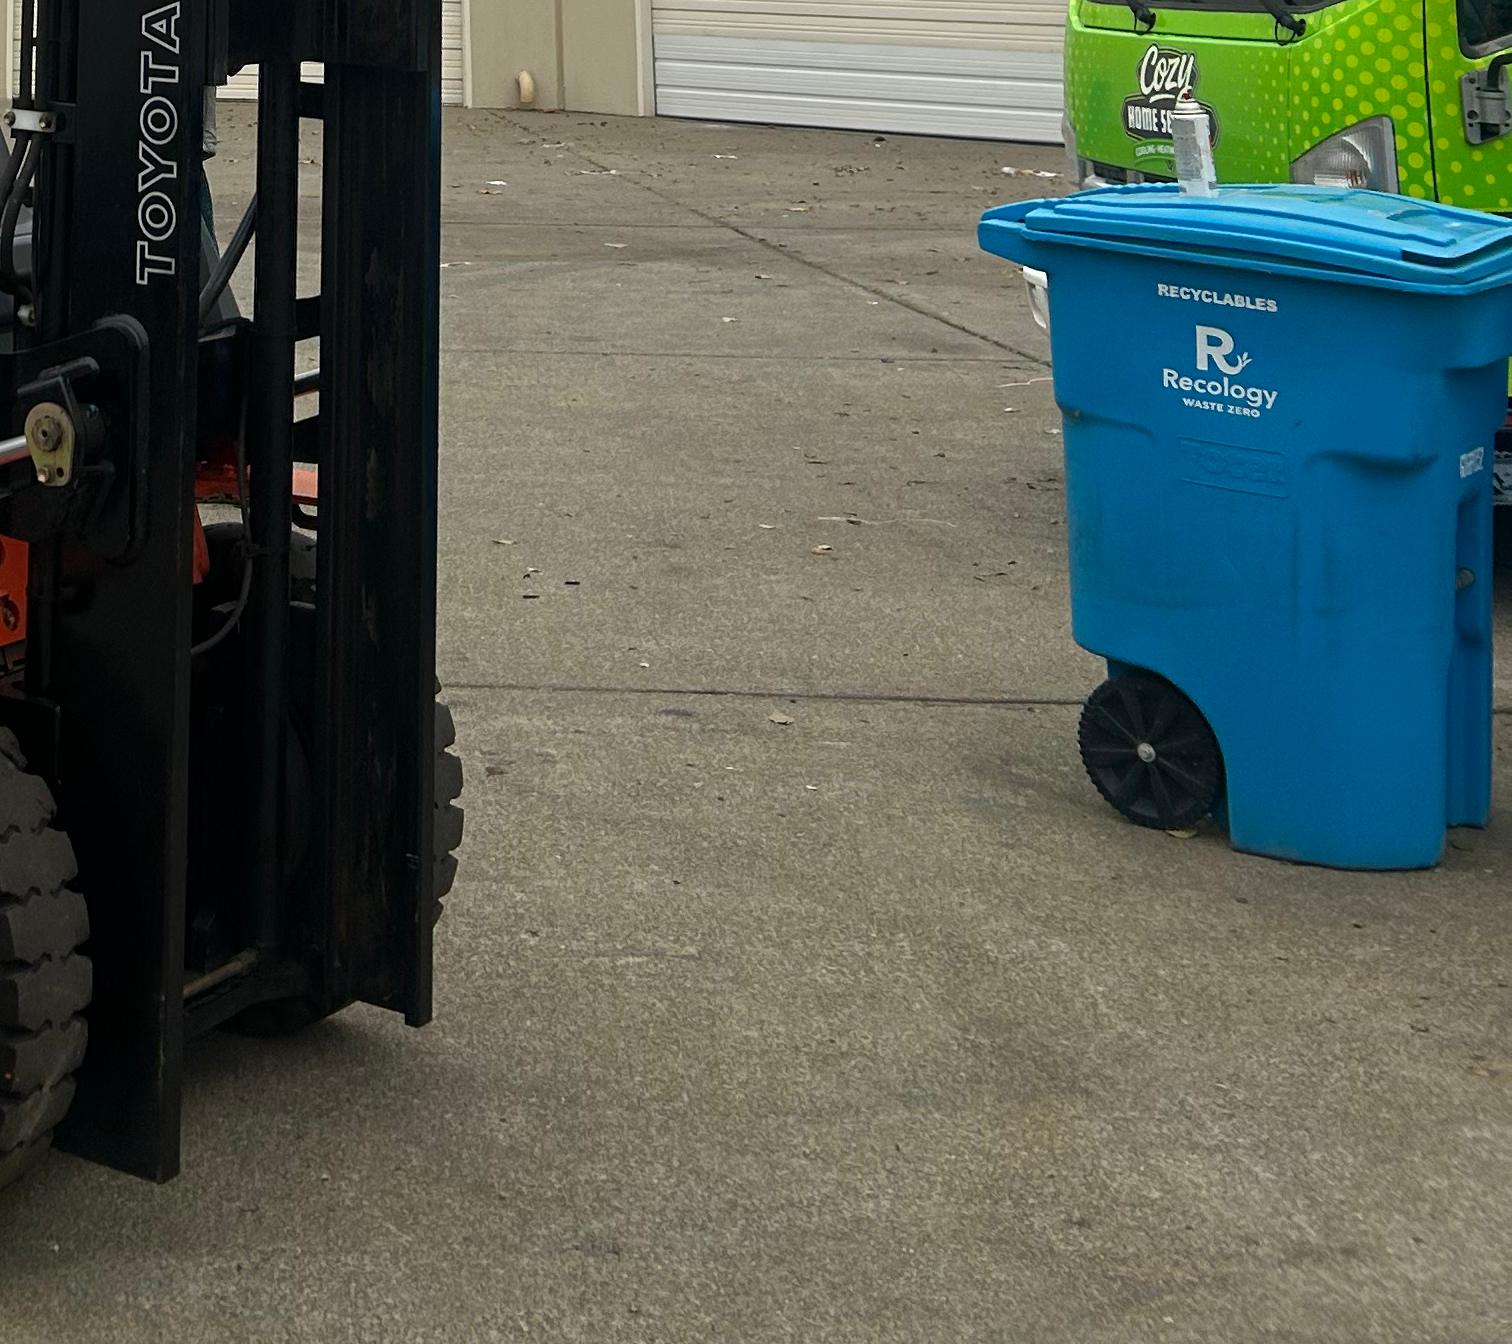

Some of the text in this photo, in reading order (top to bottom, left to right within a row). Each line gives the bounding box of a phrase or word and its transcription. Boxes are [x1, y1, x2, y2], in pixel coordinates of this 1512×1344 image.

[1139, 44, 1195, 96] Cozy
[1127, 105, 1159, 133] HOME
[136, 0, 181, 286] TOYOTA
[1157, 283, 1278, 313] RECYCLABLES
[1195, 324, 1252, 376] R
[1162, 368, 1278, 409] Recology
[1182, 397, 1261, 418] WASTE ZERO
